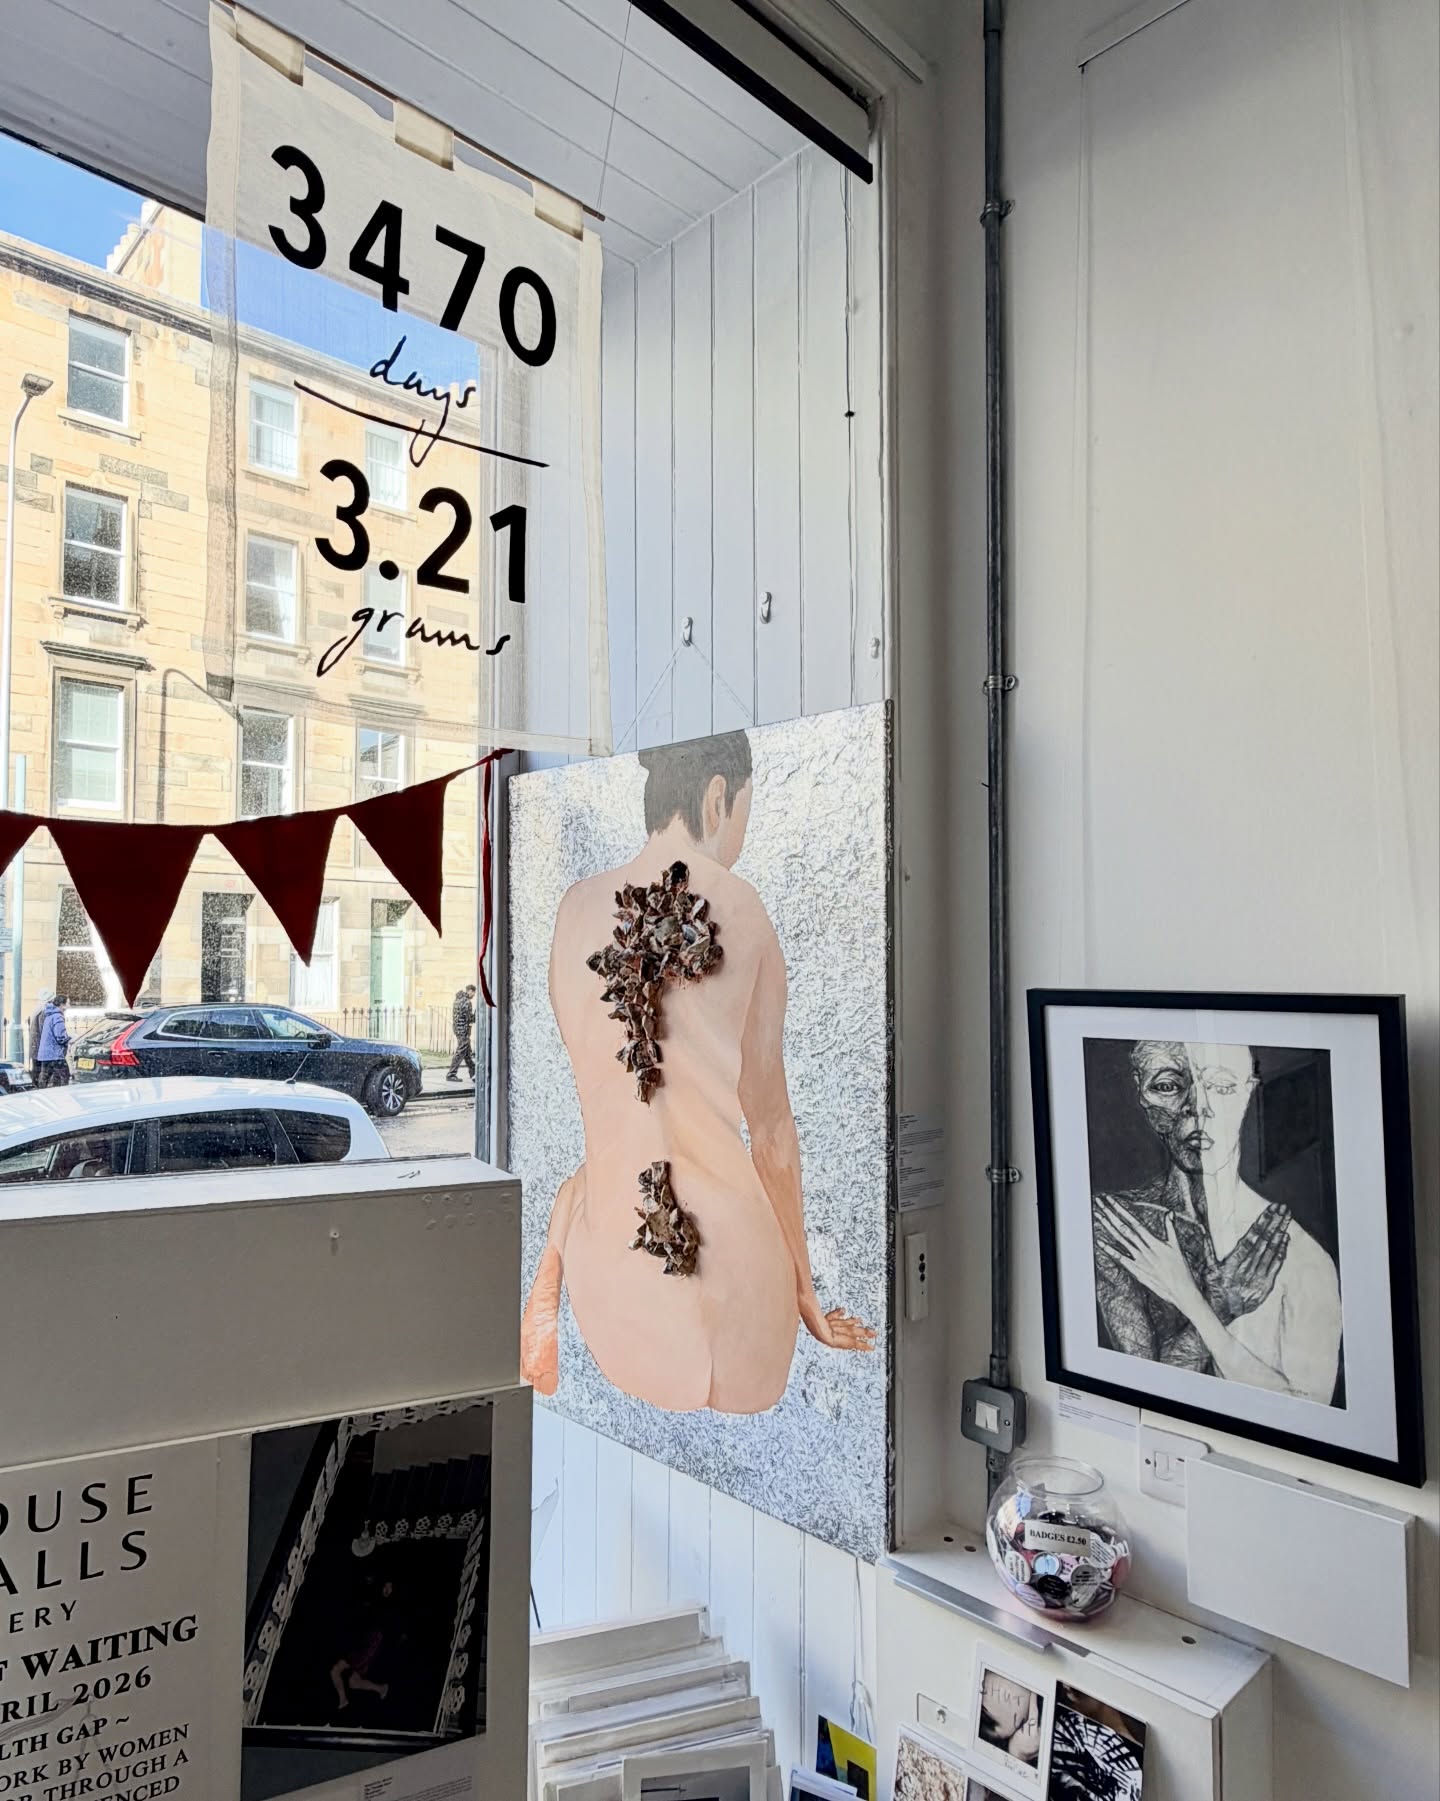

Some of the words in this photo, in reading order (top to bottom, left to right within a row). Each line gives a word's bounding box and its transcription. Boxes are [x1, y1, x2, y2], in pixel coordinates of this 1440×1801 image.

[268, 144, 557, 368] 3470
[369, 336, 477, 468] days
[314, 458, 528, 604] 3.21
[316, 605, 511, 678] grams
[0, 1473, 153, 1537] USE
[1029, 1529, 1065, 1543] BADGES
[1066, 1535, 1087, 1546] £2.50
[9, 1600, 77, 1634] ERY
[21, 1614, 199, 1681] WAITING
[0, 1691, 60, 1725] RIL
[72, 1665, 152, 1706] 2026
[56, 1717, 108, 1745] GAP
[58, 1752, 91, 1777] BY
[98, 1723, 190, 1764] WOMEN
[43, 1754, 167, 1801] THROUGH
[173, 1748, 190, 1768] A
[95, 1775, 181, 1801] NCED
